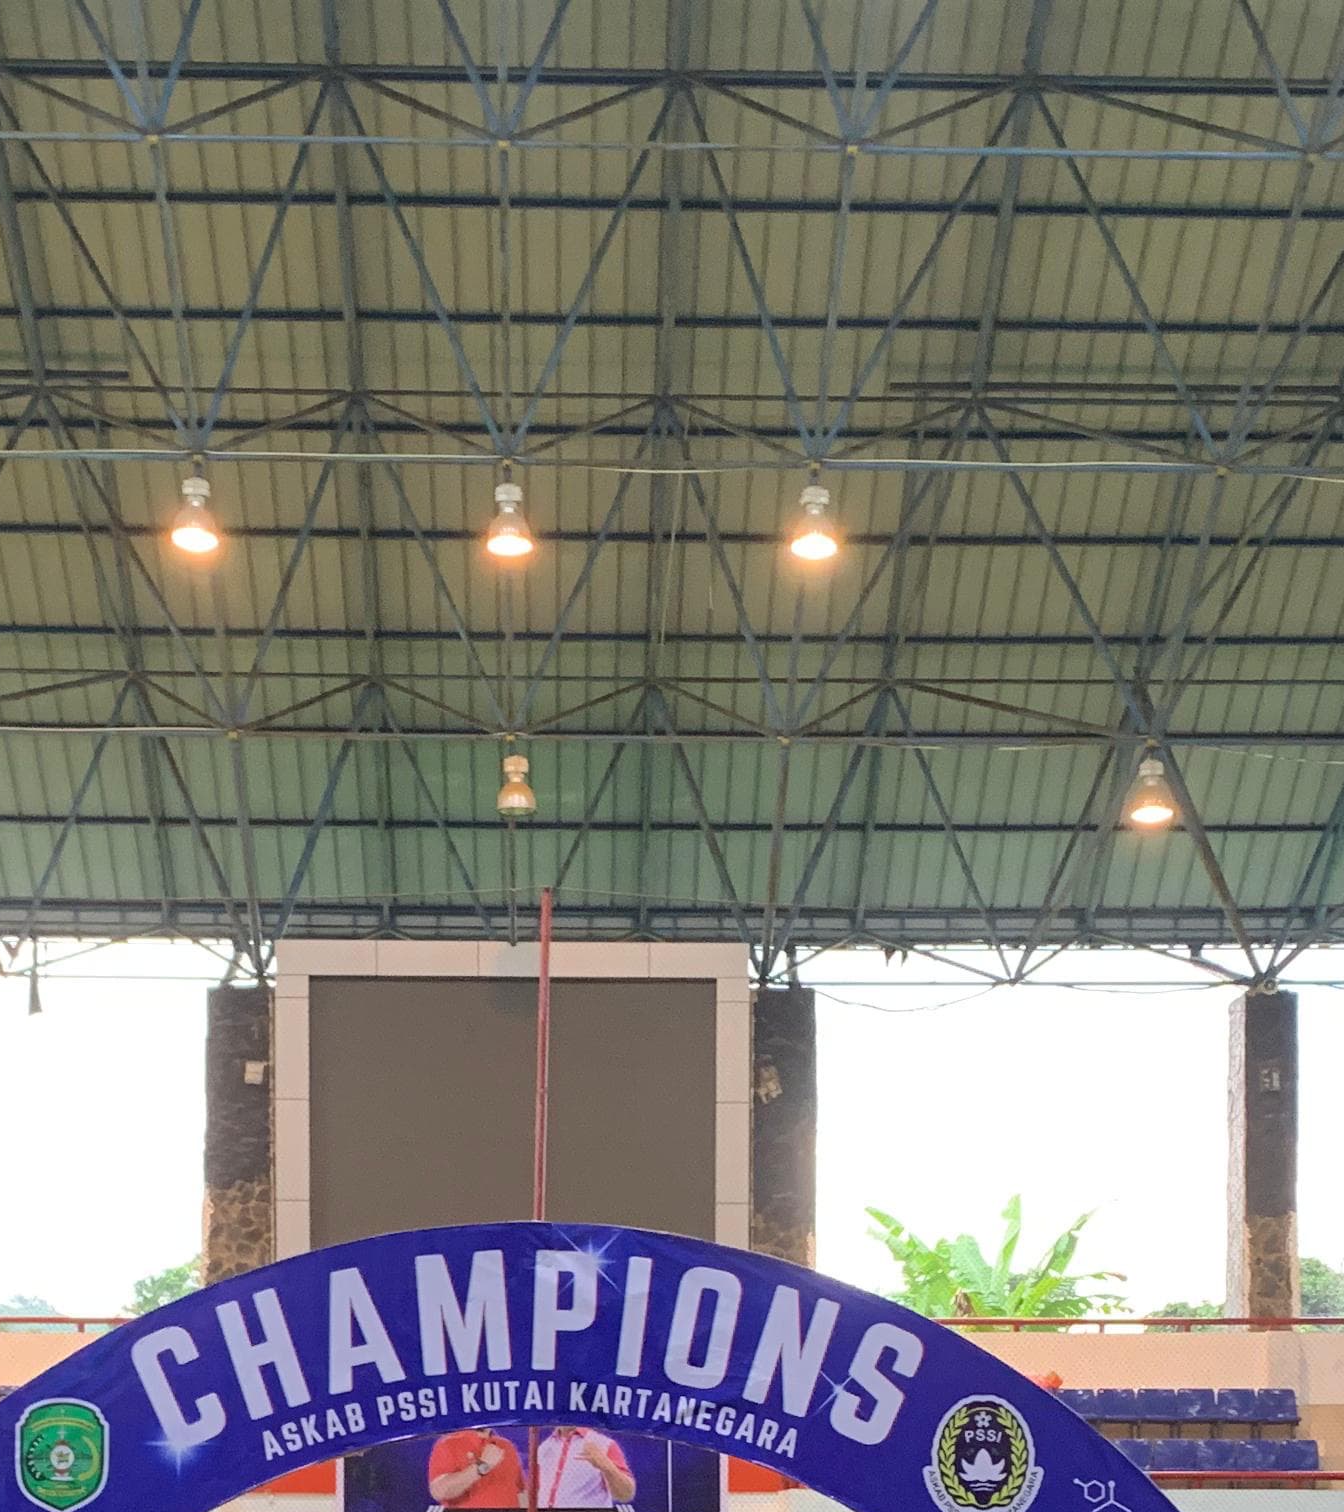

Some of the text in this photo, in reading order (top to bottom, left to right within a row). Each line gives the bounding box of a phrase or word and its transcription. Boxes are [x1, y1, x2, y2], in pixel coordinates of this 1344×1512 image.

[130, 1249, 924, 1448] CHAMPIONS
[262, 1380, 798, 1461] ASKAB PSSI KUTAI KARTANEGARA
[964, 1429, 1002, 1443] PSSI
